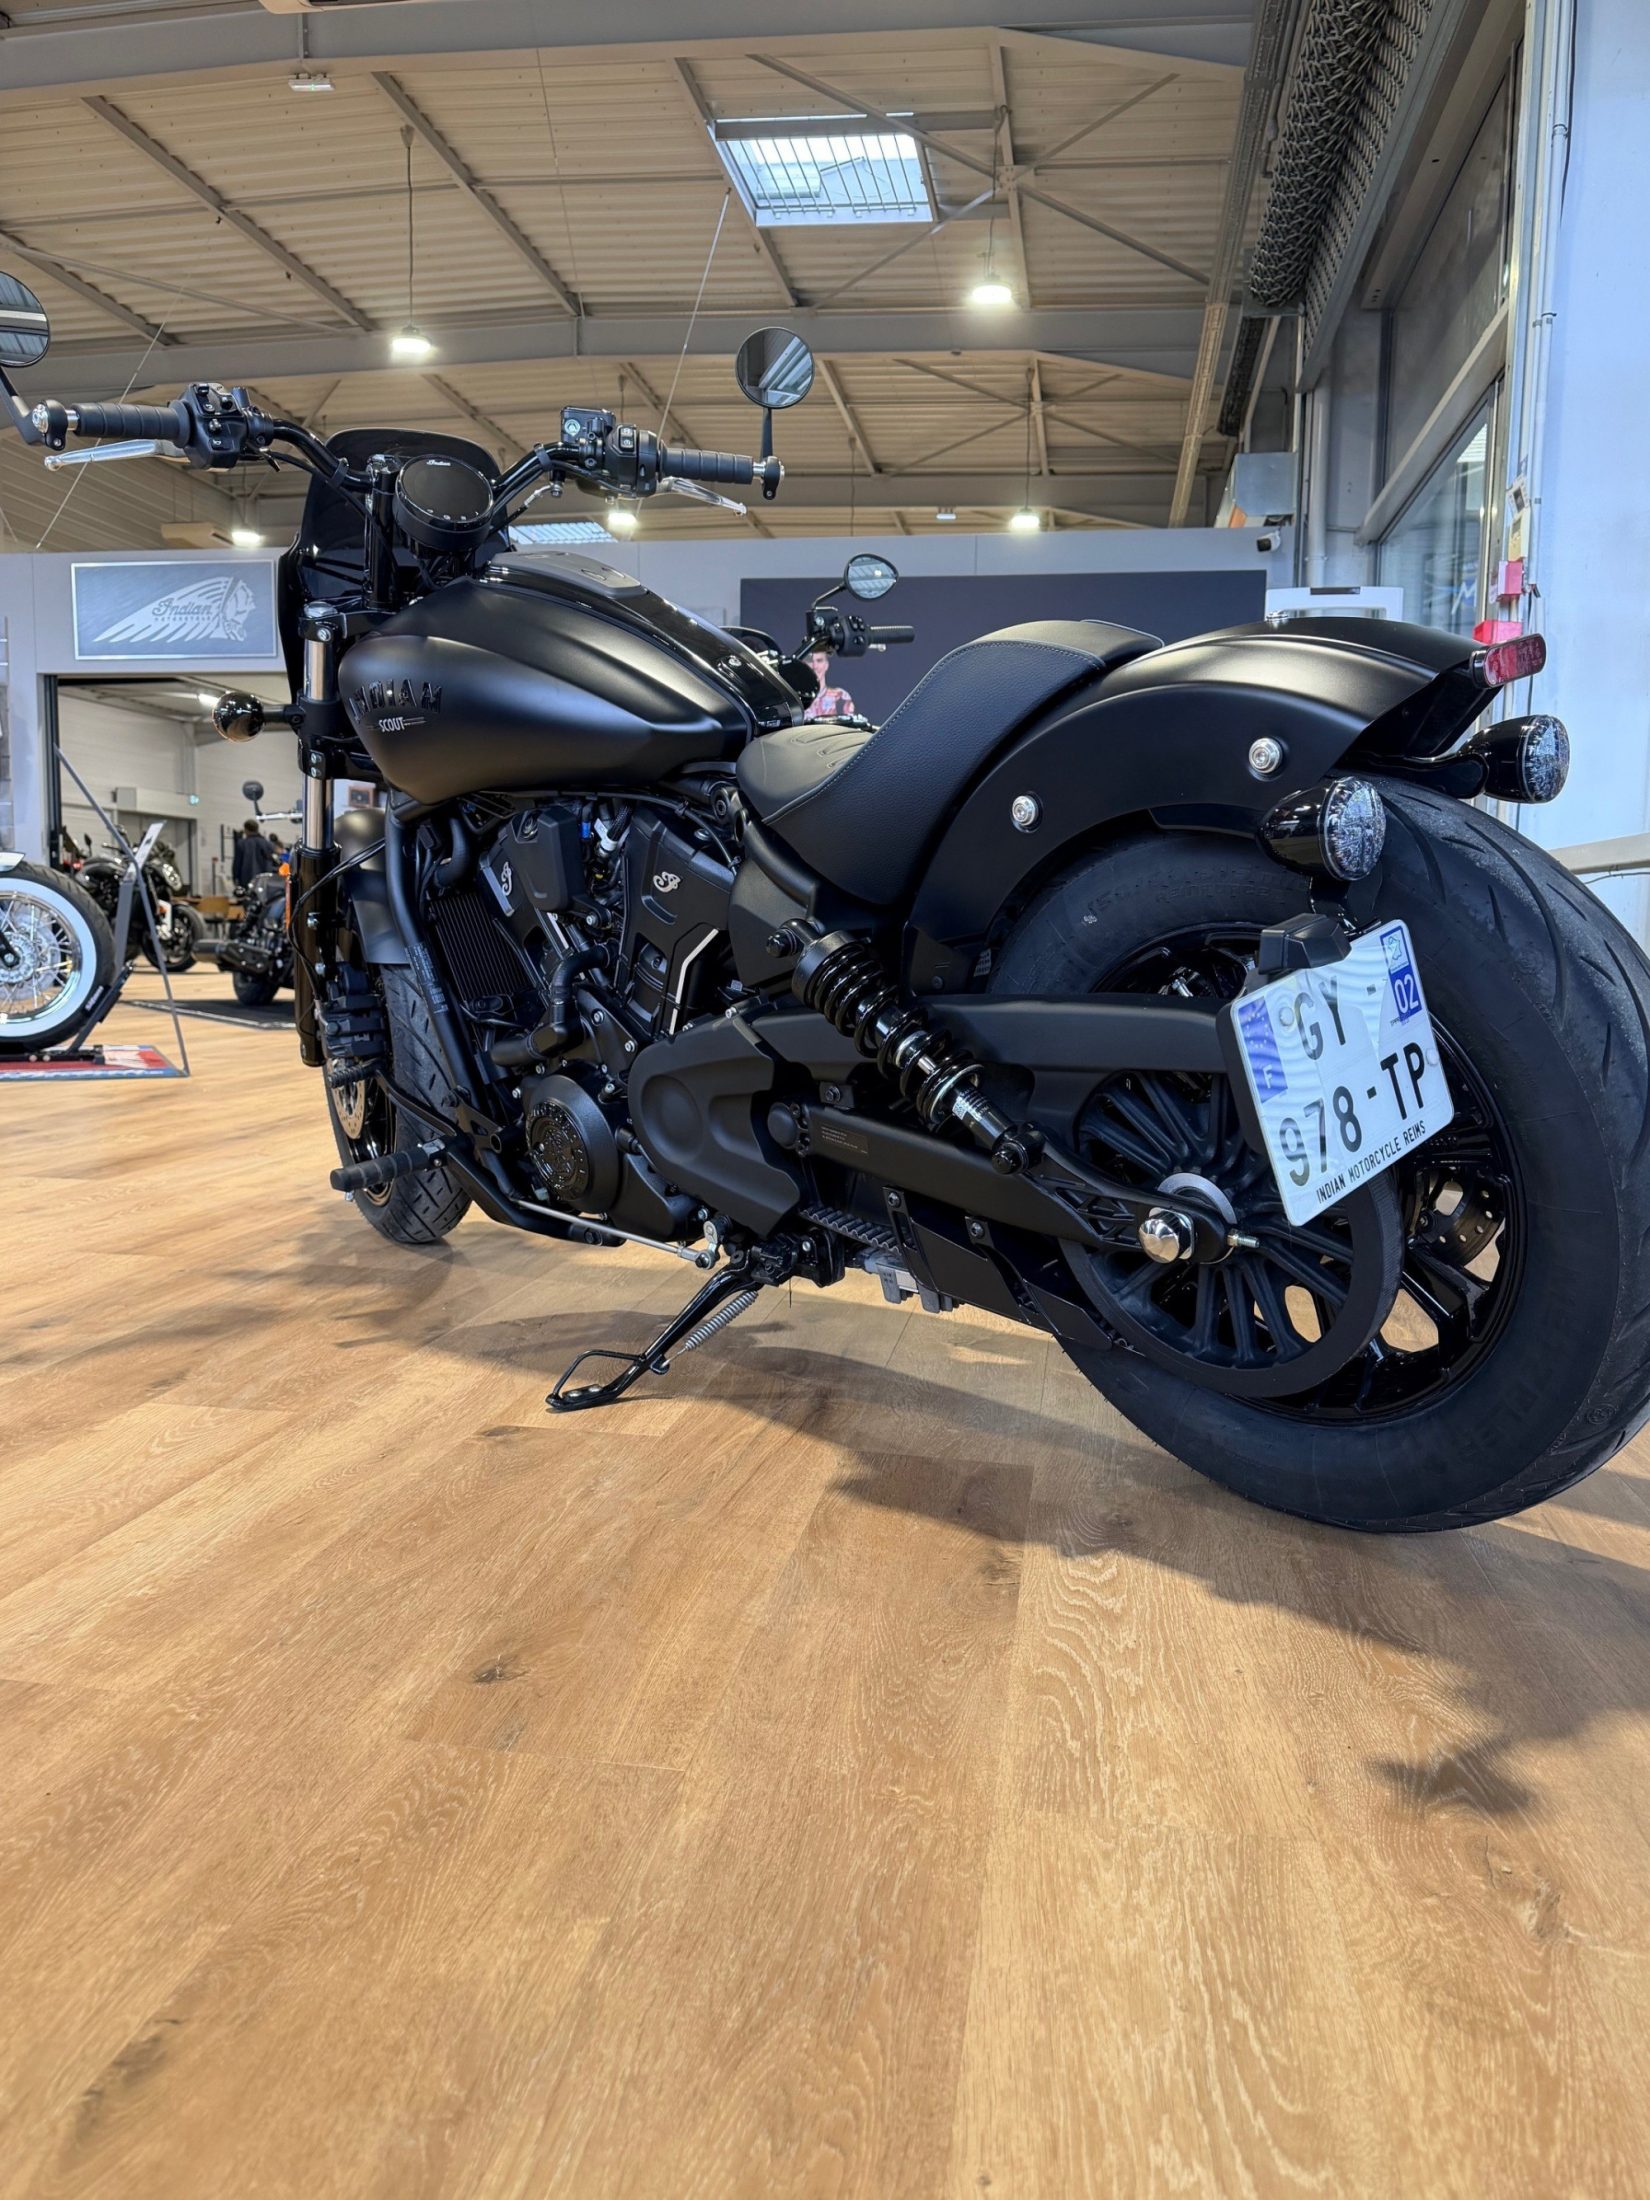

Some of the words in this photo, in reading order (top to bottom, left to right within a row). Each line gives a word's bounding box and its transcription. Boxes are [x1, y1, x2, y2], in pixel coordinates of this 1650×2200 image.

[152, 598, 212, 616] Indian
[379, 717, 404, 732] SCOUT
[1394, 974, 1419, 1014] 02
[1263, 1064, 1273, 1089] F
[1316, 1174, 1346, 1204] INDIAN
[1348, 1137, 1402, 1184] MOTORCYCLE
[1403, 1120, 1426, 1147] REIMS
